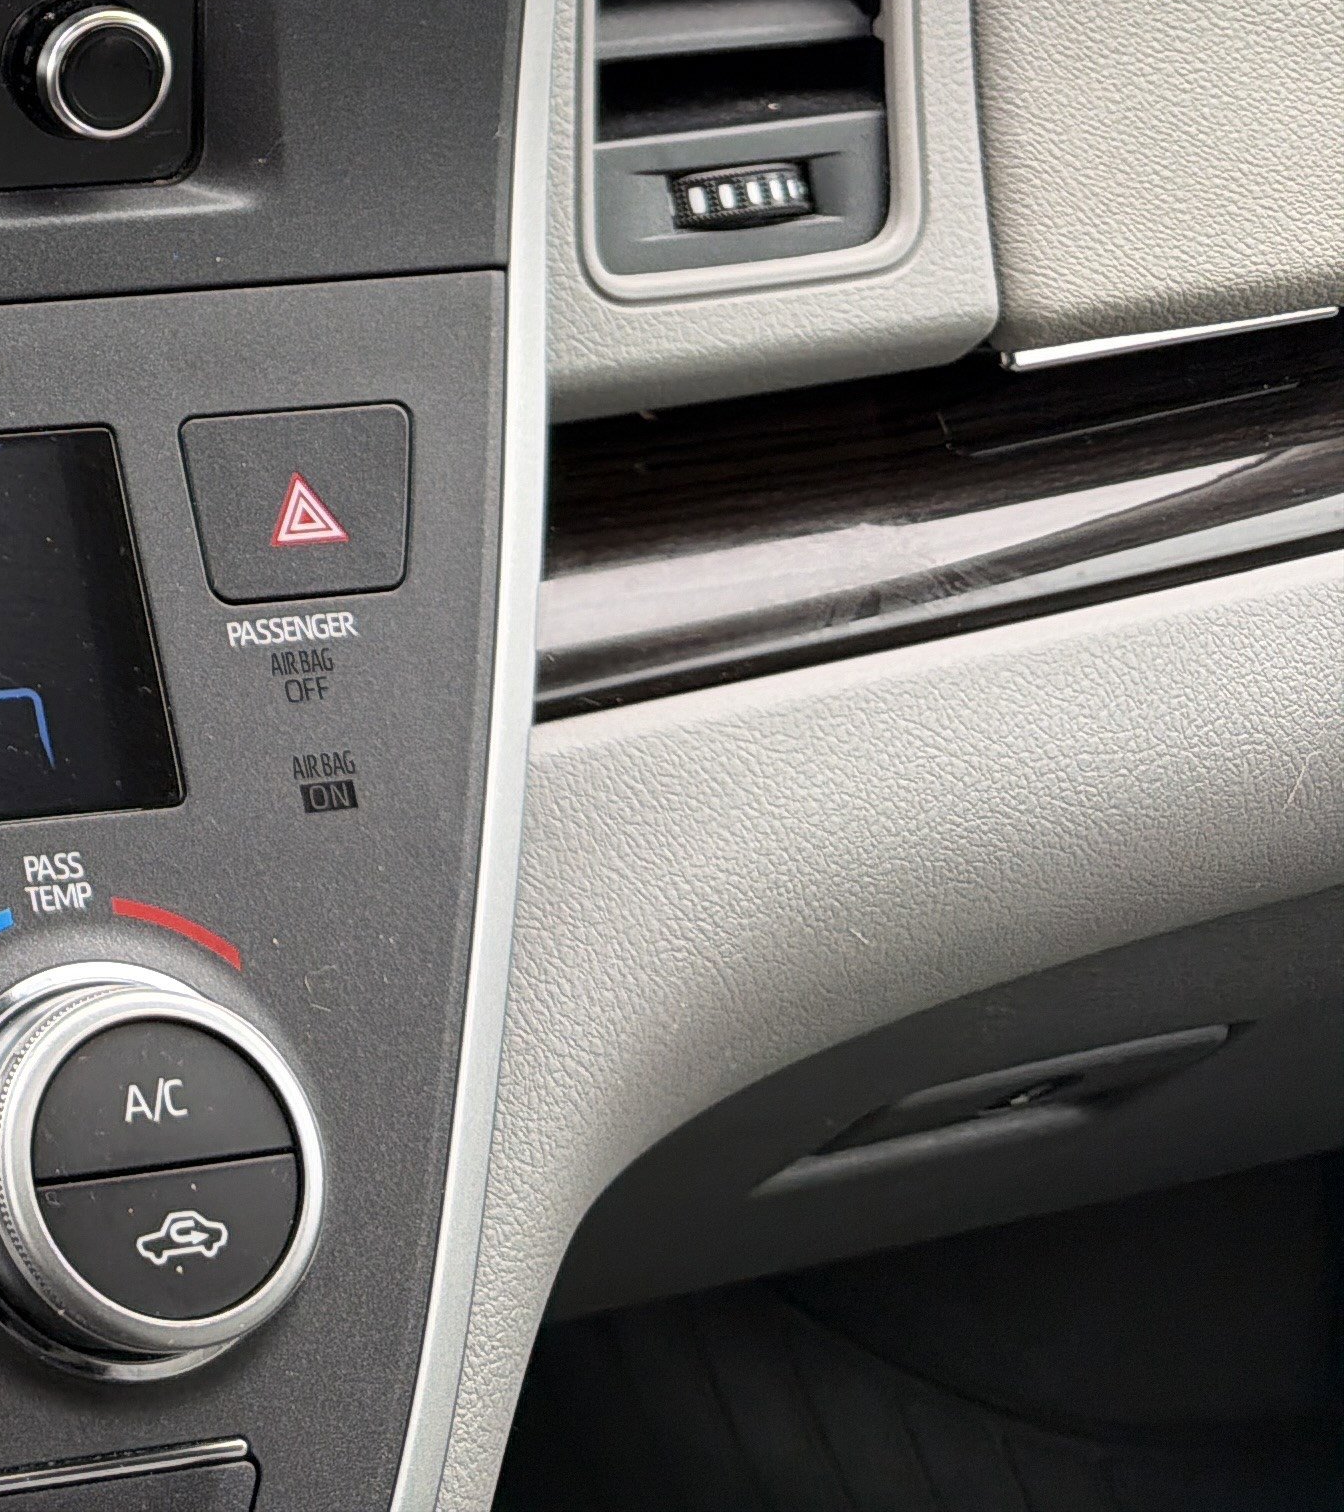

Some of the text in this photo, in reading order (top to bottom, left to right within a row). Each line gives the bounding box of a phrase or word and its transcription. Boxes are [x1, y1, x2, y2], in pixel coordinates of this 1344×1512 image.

[226, 610, 361, 648] PASSENGER
[284, 675, 330, 704] OFF
[308, 781, 352, 811] ON
[23, 851, 84, 884] PASS
[23, 881, 92, 913] TEMP
[123, 1077, 190, 1123] A/C
